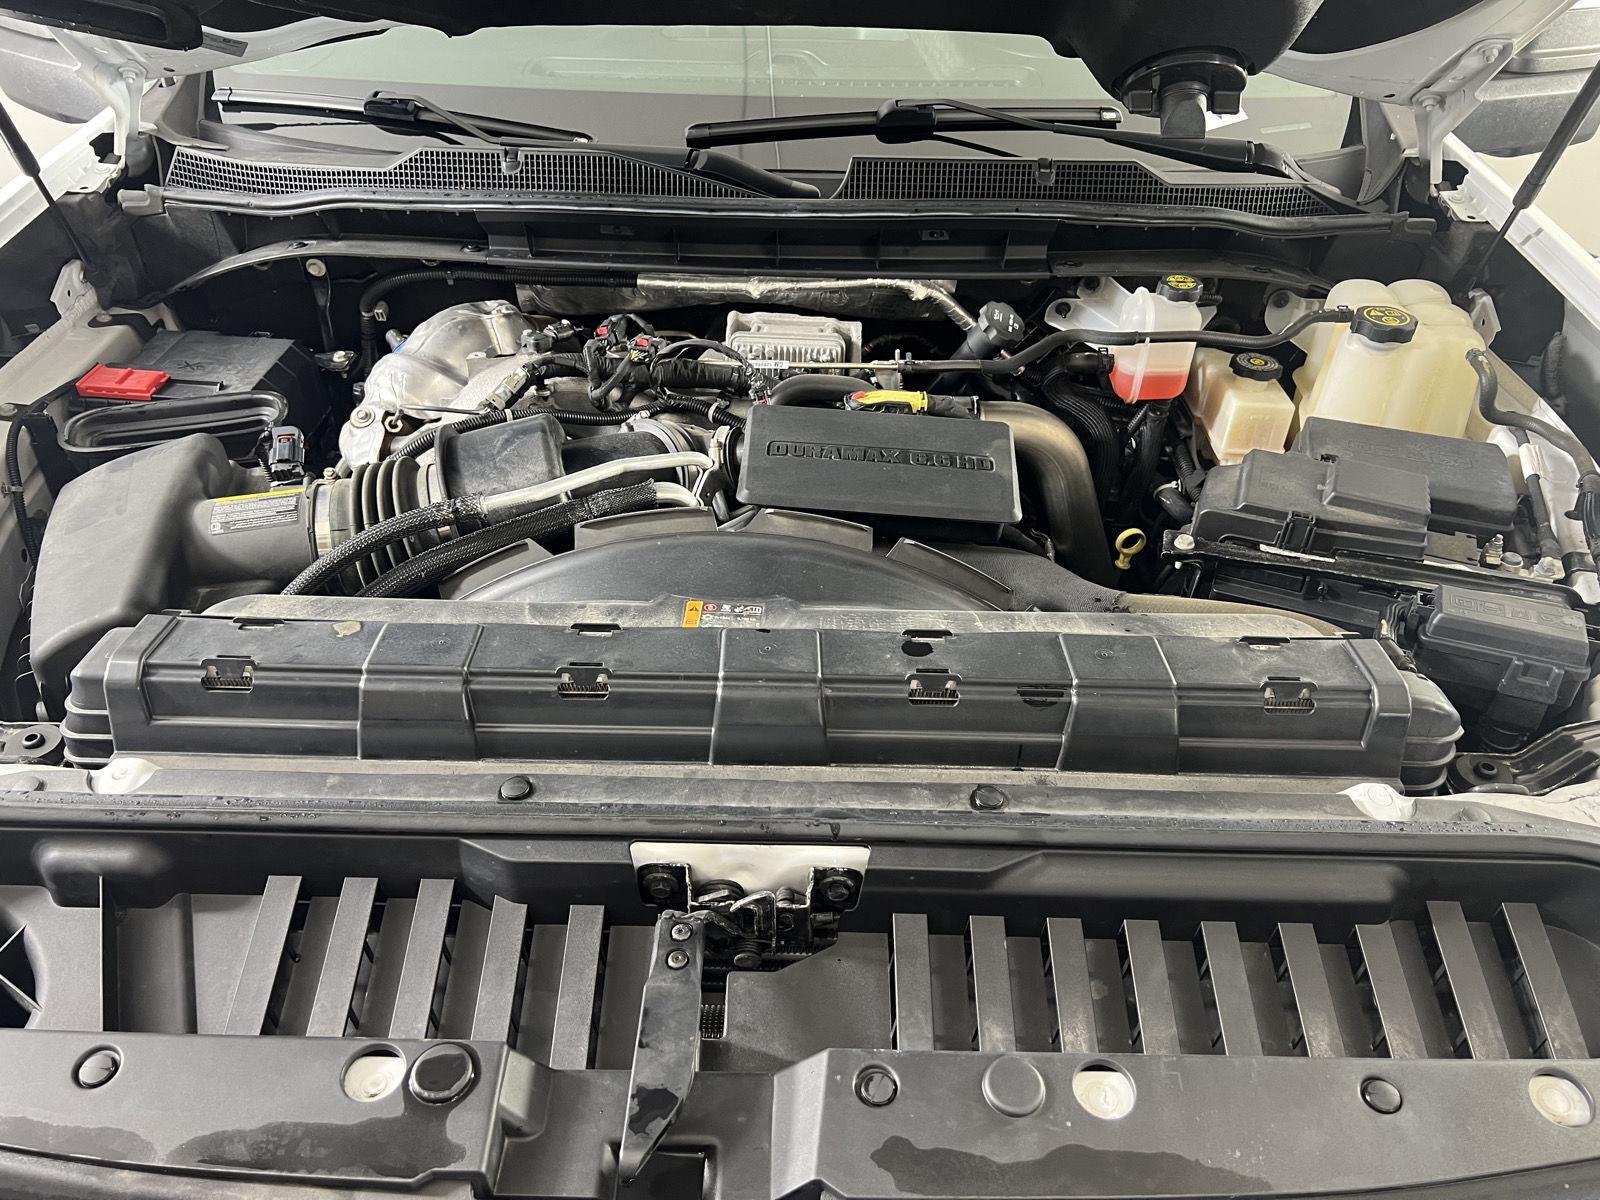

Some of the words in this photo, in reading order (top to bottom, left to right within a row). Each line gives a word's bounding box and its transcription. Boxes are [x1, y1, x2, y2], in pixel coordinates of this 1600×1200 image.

[769, 442, 901, 463] DURAMAX
[910, 452, 951, 467] 6.6
[956, 455, 994, 471] HD
